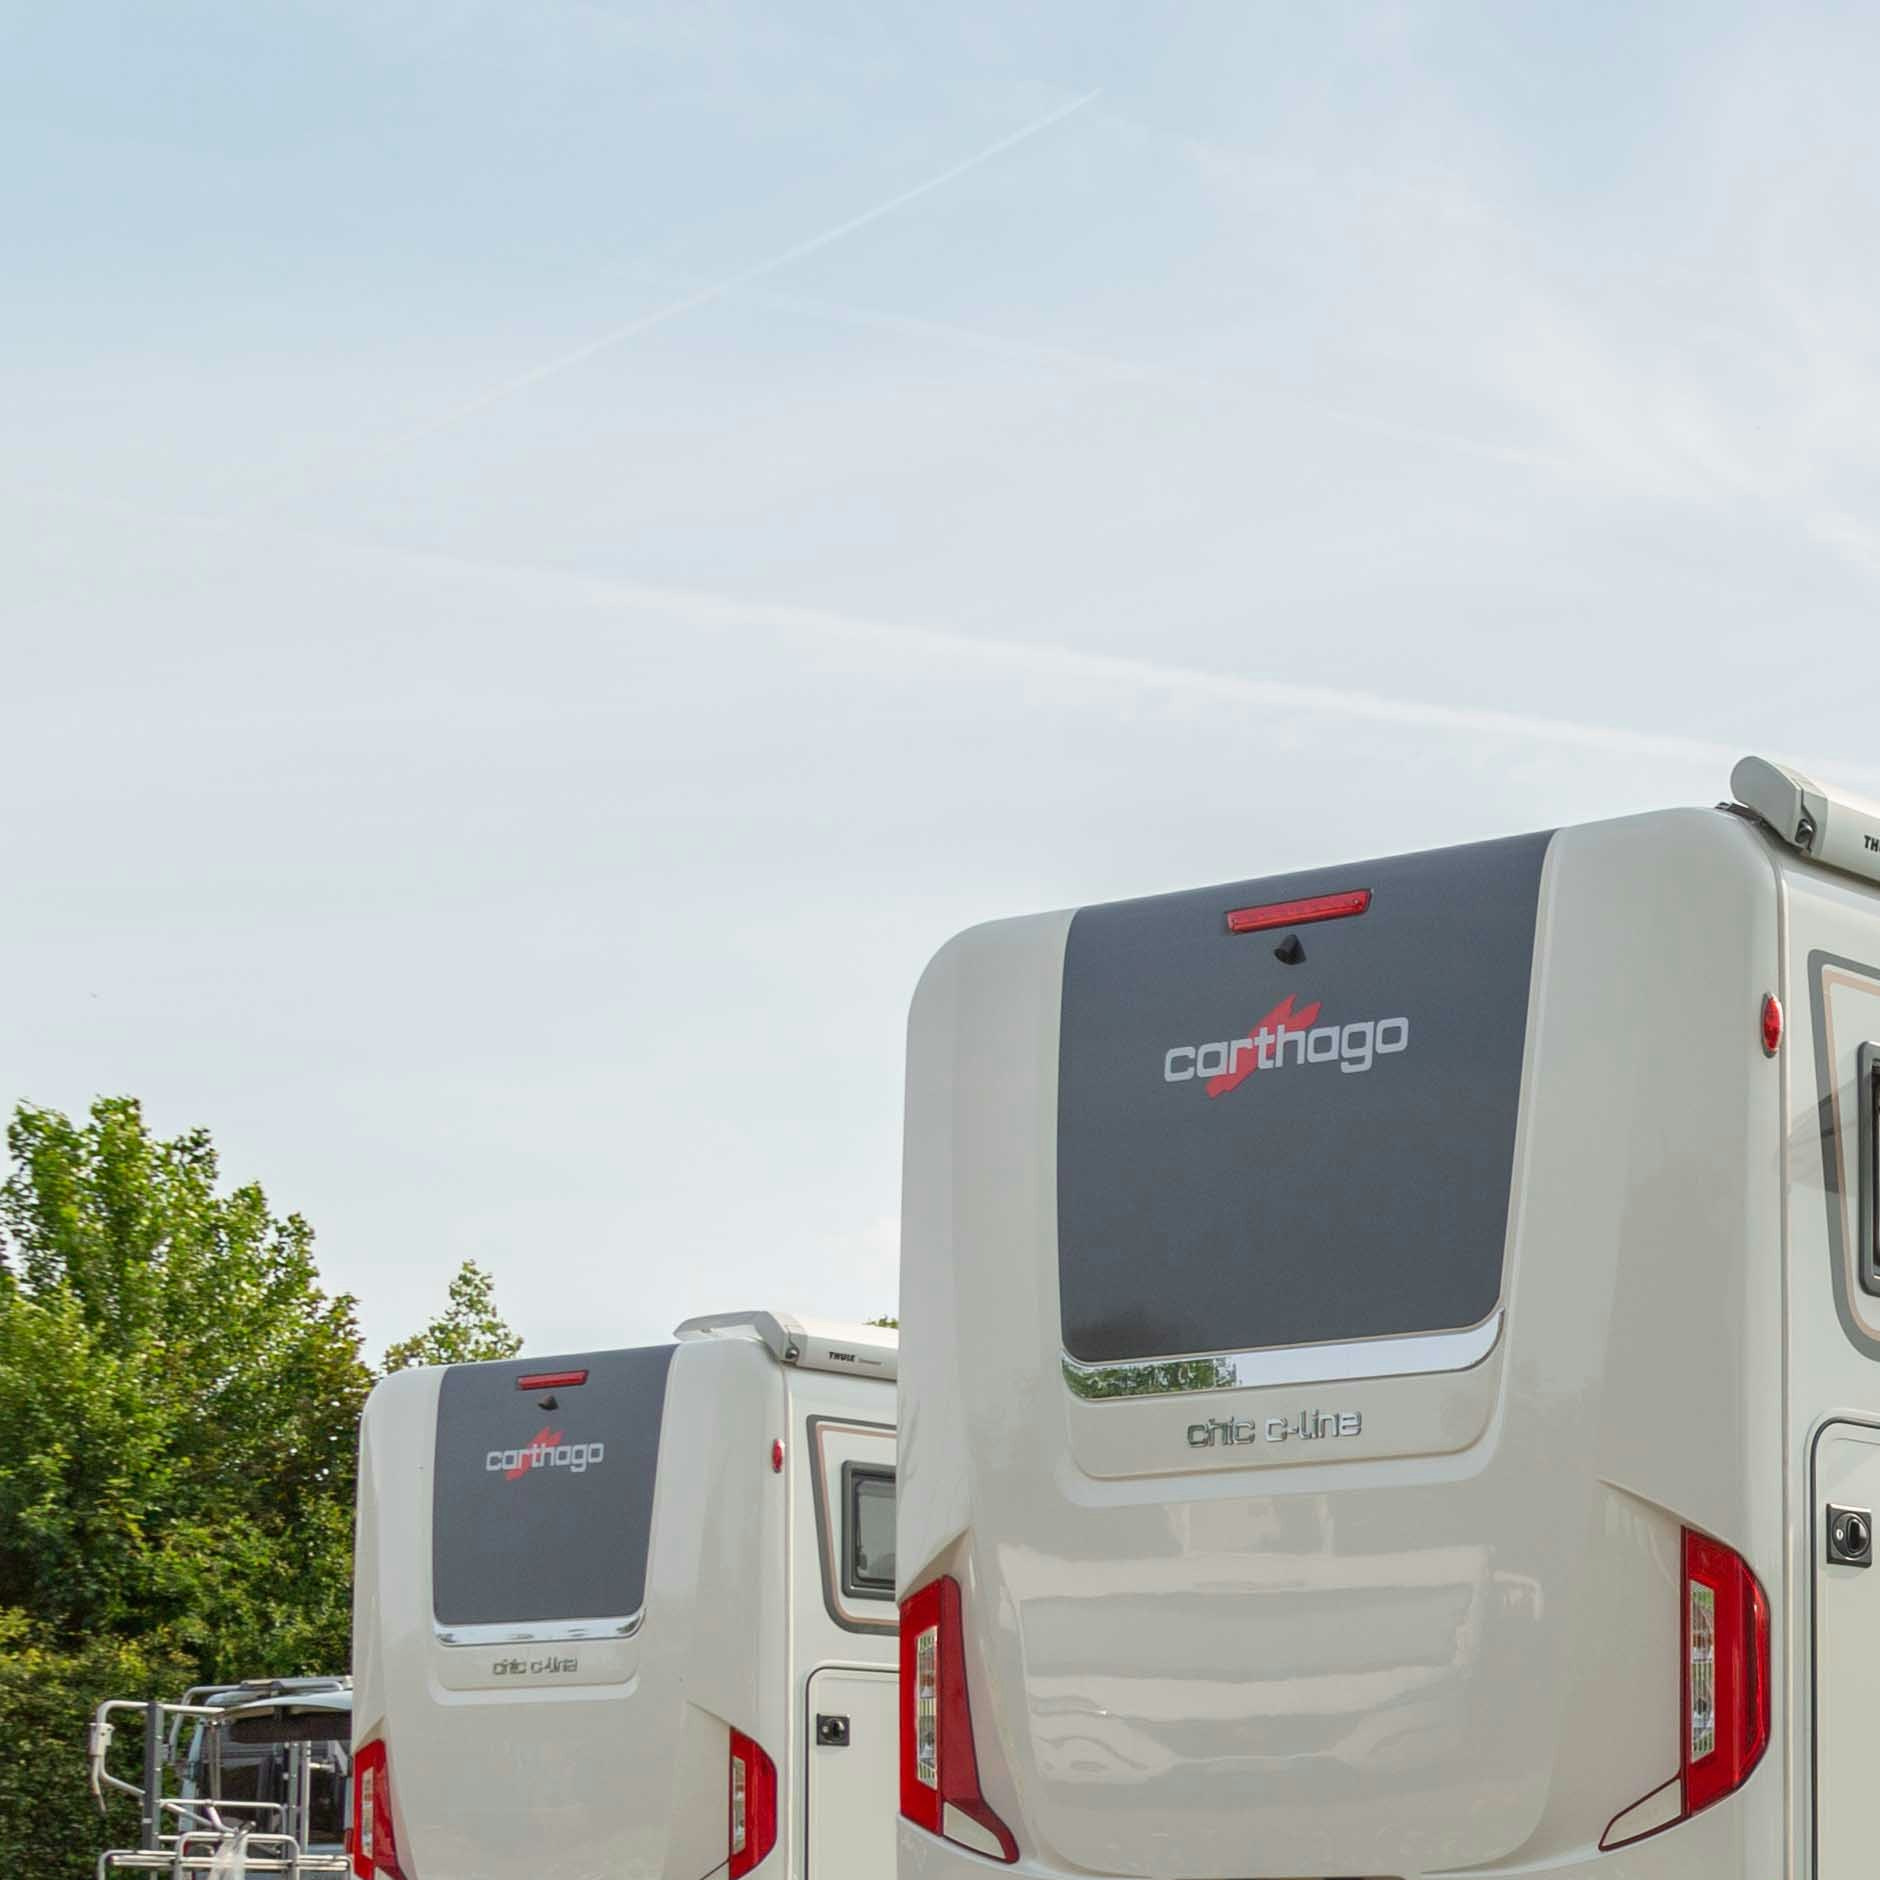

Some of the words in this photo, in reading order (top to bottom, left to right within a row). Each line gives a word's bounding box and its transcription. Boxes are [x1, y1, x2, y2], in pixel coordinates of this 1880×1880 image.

[1163, 1016, 1409, 1083] carthago
[1186, 1415, 1256, 1448] chic
[1264, 1408, 1363, 1442] c-line
[485, 1442, 605, 1473] carthago
